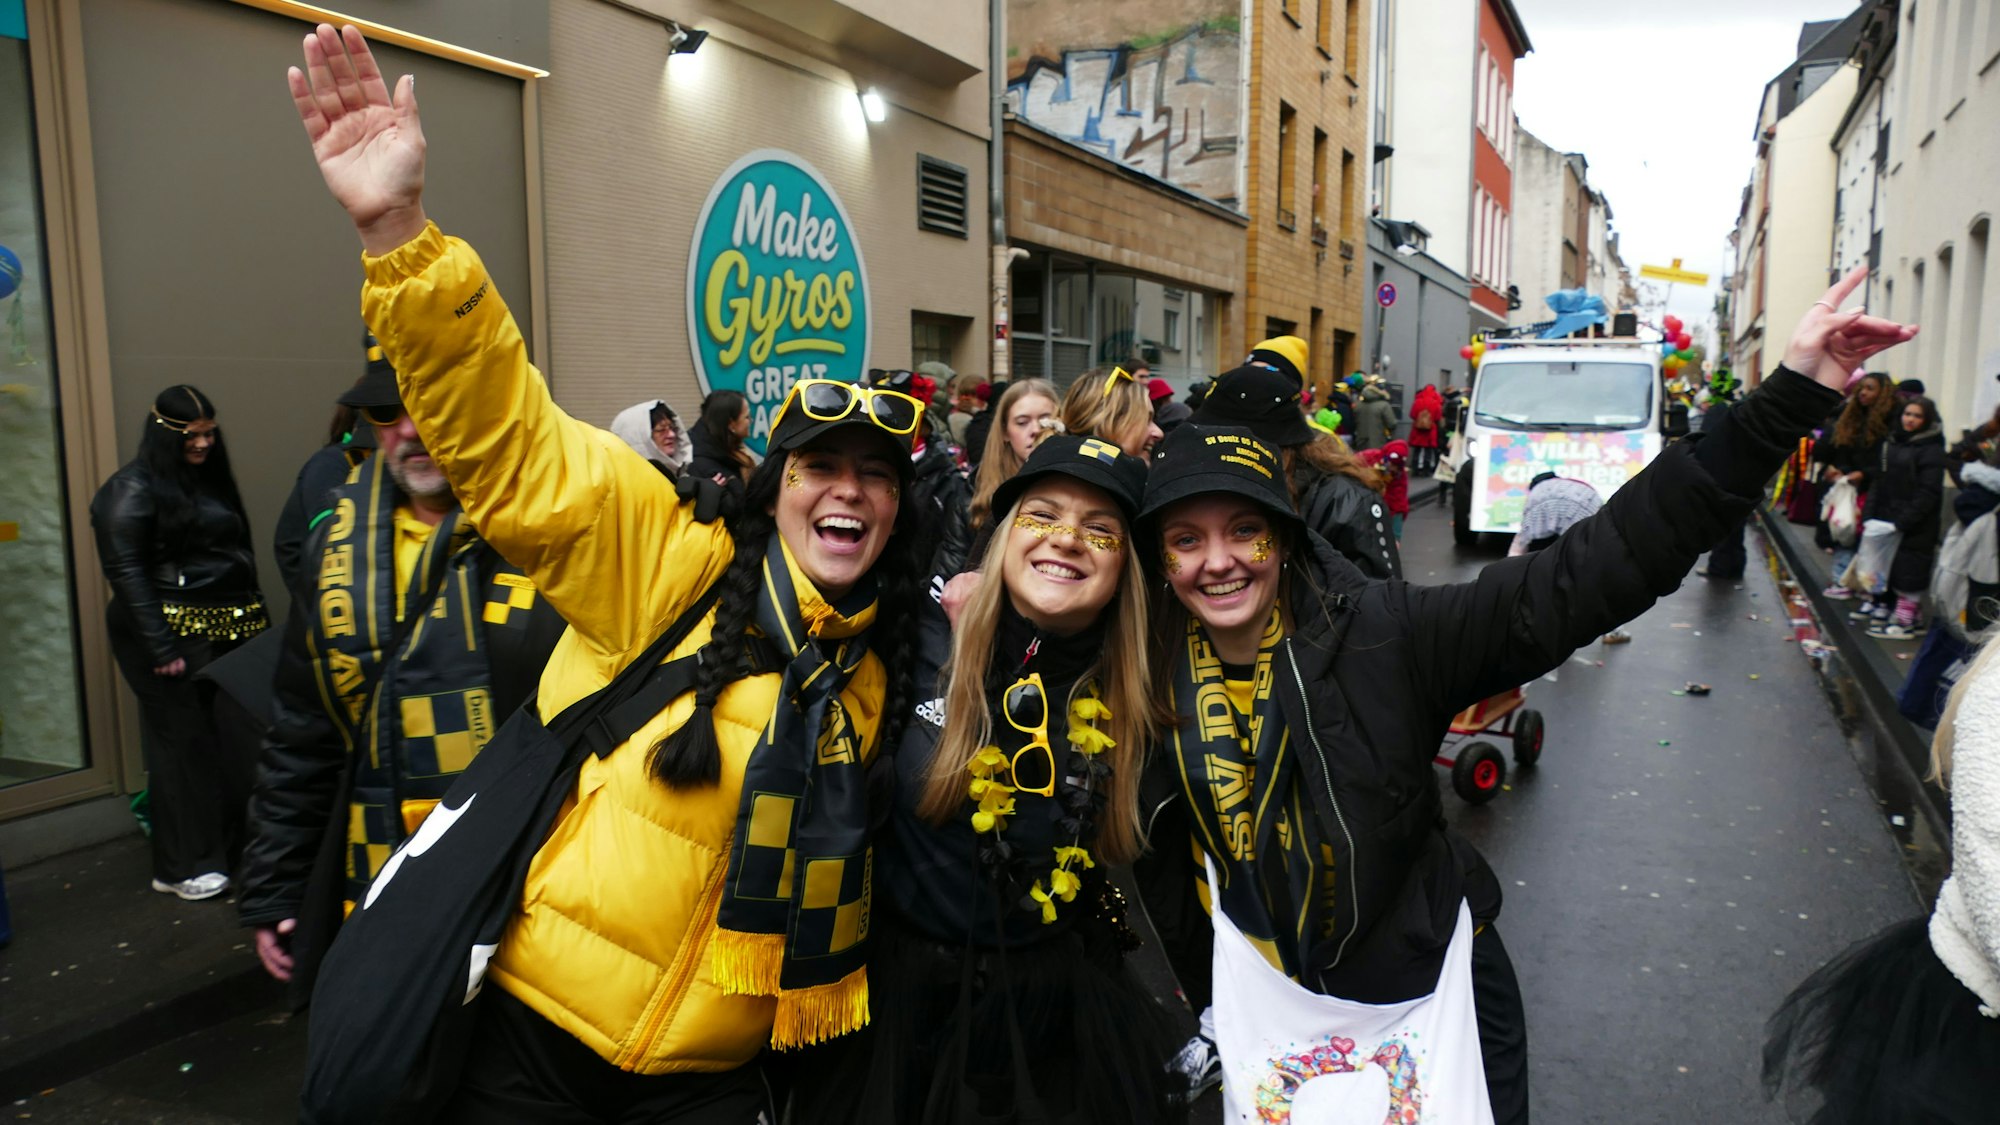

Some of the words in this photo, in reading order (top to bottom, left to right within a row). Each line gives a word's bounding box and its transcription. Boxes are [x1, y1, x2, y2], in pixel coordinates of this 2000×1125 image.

[732, 182, 839, 261] Make
[704, 250, 854, 366] Gyros
[1530, 442, 1600, 460] VILLA
[1204, 753, 1256, 863] SV
[858, 911, 868, 935] 05
